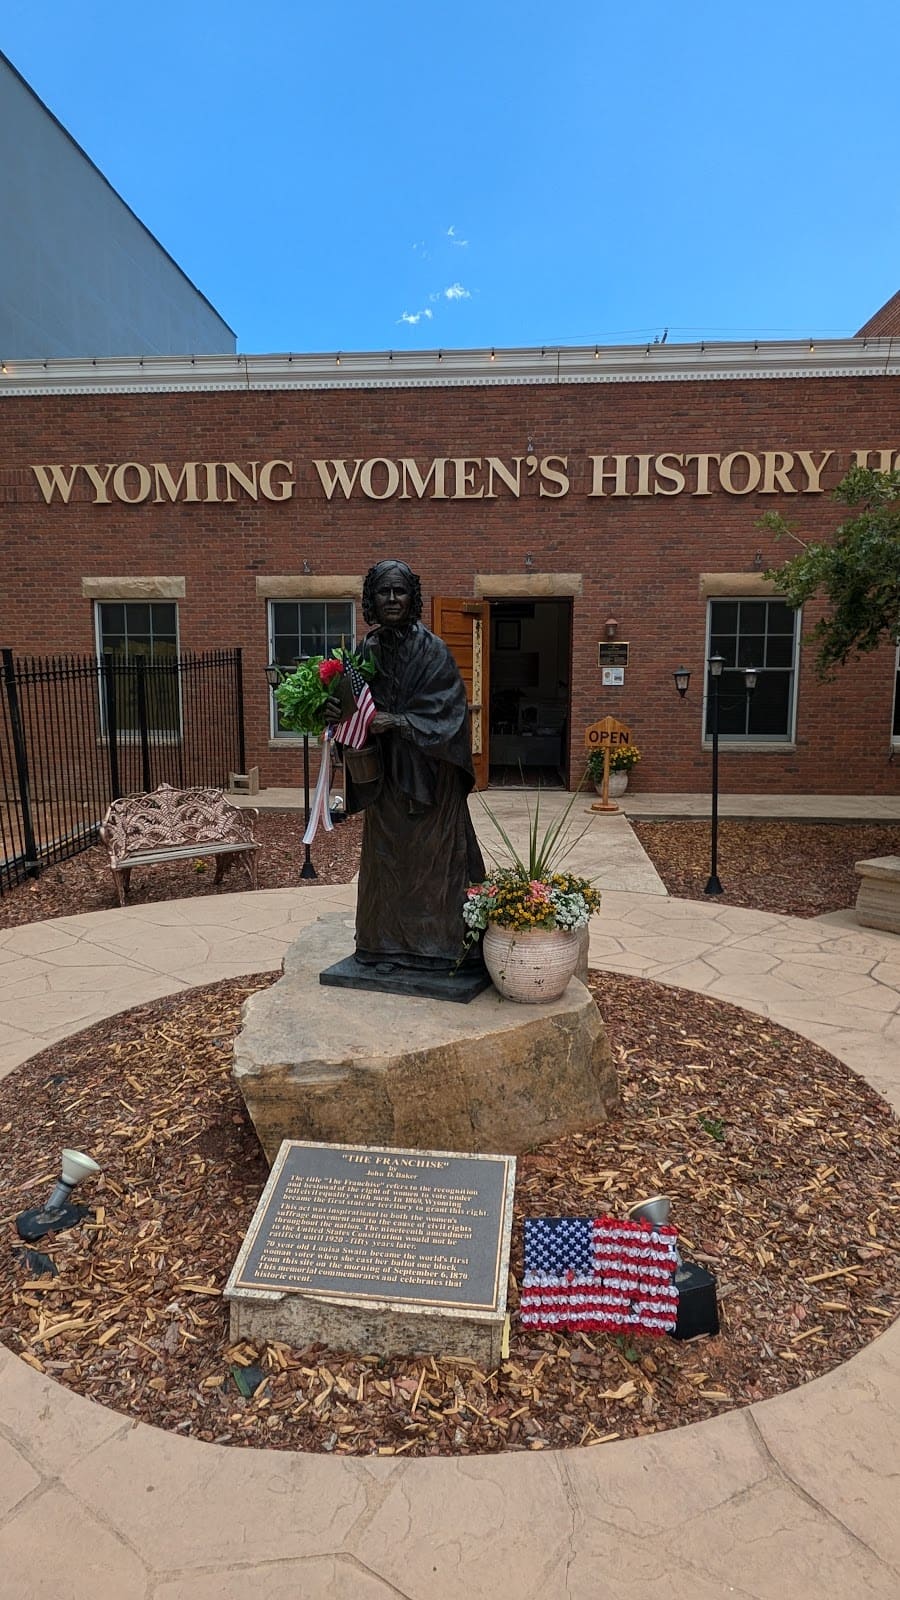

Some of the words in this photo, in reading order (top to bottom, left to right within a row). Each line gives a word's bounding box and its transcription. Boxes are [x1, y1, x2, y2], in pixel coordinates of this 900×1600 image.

[30, 460, 296, 504] WYOMING
[312, 456, 570, 500] WOMEN'S
[587, 450, 835, 497] HISTORY
[589, 730, 629, 744] OPEN
[303, 1182, 337, 1190] bestowal
[360, 1187, 381, 1195] right
[433, 1187, 478, 1197] recognition
[282, 1194, 312, 1202] became
[377, 1202, 412, 1211] territory
[425, 1206, 447, 1214] grant
[318, 1190, 351, 1199] equality
[425, 1199, 462, 1209] Wyoming
[276, 1210, 310, 1219] suffrage
[311, 1213, 350, 1222] movement
[447, 1224, 472, 1233] rights
[328, 1207, 379, 1218] inspirational
[273, 1217, 319, 1227] throughout
[334, 1222, 362, 1230] nation.
[380, 1226, 424, 1235] nineteenth
[426, 1230, 472, 1239] amendment
[296, 1226, 324, 1234] United
[325, 1228, 350, 1236] States
[351, 1231, 403, 1241] Constitution
[405, 1235, 430, 1243] would
[268, 1231, 301, 1239] ratified
[349, 1238, 369, 1246] fifty
[372, 1241, 394, 1249] years
[294, 1250, 314, 1258] voter
[317, 1252, 339, 1260] when
[391, 1259, 416, 1267] ballot
[434, 1263, 457, 1271] block
[312, 1244, 340, 1253] Louisa
[342, 1247, 368, 1255] Swain
[370, 1250, 402, 1258] became
[403, 1252, 416, 1260] the
[419, 1254, 448, 1262] world's
[254, 1270, 287, 1280] historic
[288, 1274, 314, 1282] event.
[257, 1263, 277, 1271] This
[277, 1265, 318, 1274] memorial
[318, 1268, 380, 1280] commemorates
[382, 1274, 398, 1282] and
[400, 1276, 443, 1286] celebrates
[259, 1255, 281, 1263] from
[282, 1257, 299, 1265] this
[328, 1261, 342, 1269] the
[343, 1263, 381, 1274] morning
[393, 1267, 439, 1279] September
